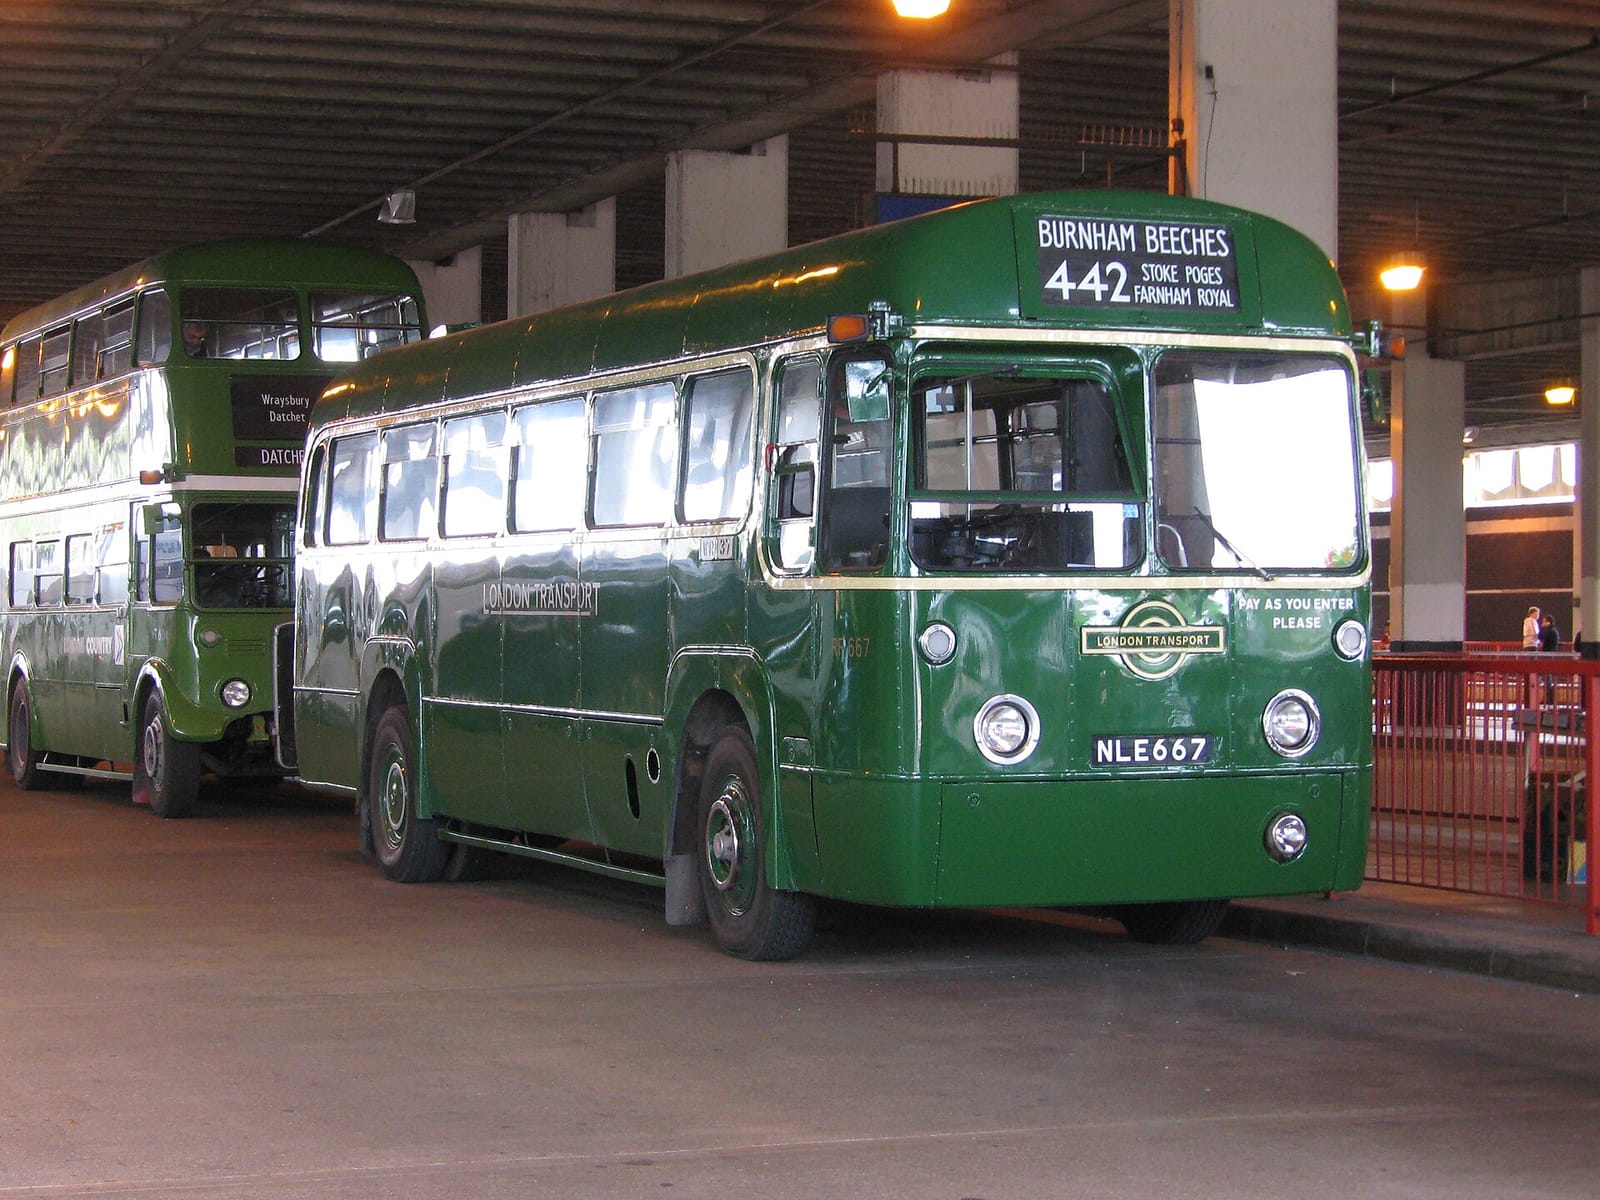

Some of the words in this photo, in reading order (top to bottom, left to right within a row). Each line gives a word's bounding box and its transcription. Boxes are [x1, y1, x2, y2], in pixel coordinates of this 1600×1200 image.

[1038, 219, 1136, 252] BURNHAM
[1145, 225, 1230, 257] BEECHES
[1044, 259, 1131, 303] 442
[1141, 263, 1179, 283] STOKE
[1185, 265, 1223, 285] POGES
[1134, 285, 1192, 306] FARNHAM
[1197, 287, 1235, 308] ROYAL
[261, 393, 310, 409] Wraysbury
[269, 410, 306, 422] Datchet
[483, 583, 530, 615] LONDON
[534, 582, 601, 616] TRANSPORT
[1239, 598, 1260, 610] PAY
[1264, 598, 1282, 610] AS
[1286, 598, 1311, 610] YOU
[1314, 597, 1354, 610] ENTER
[1273, 617, 1321, 629] PLEASE
[1097, 635, 1143, 647] LONDON
[1146, 634, 1210, 646] TRANSPORT
[1097, 738, 1206, 763] NLE667
